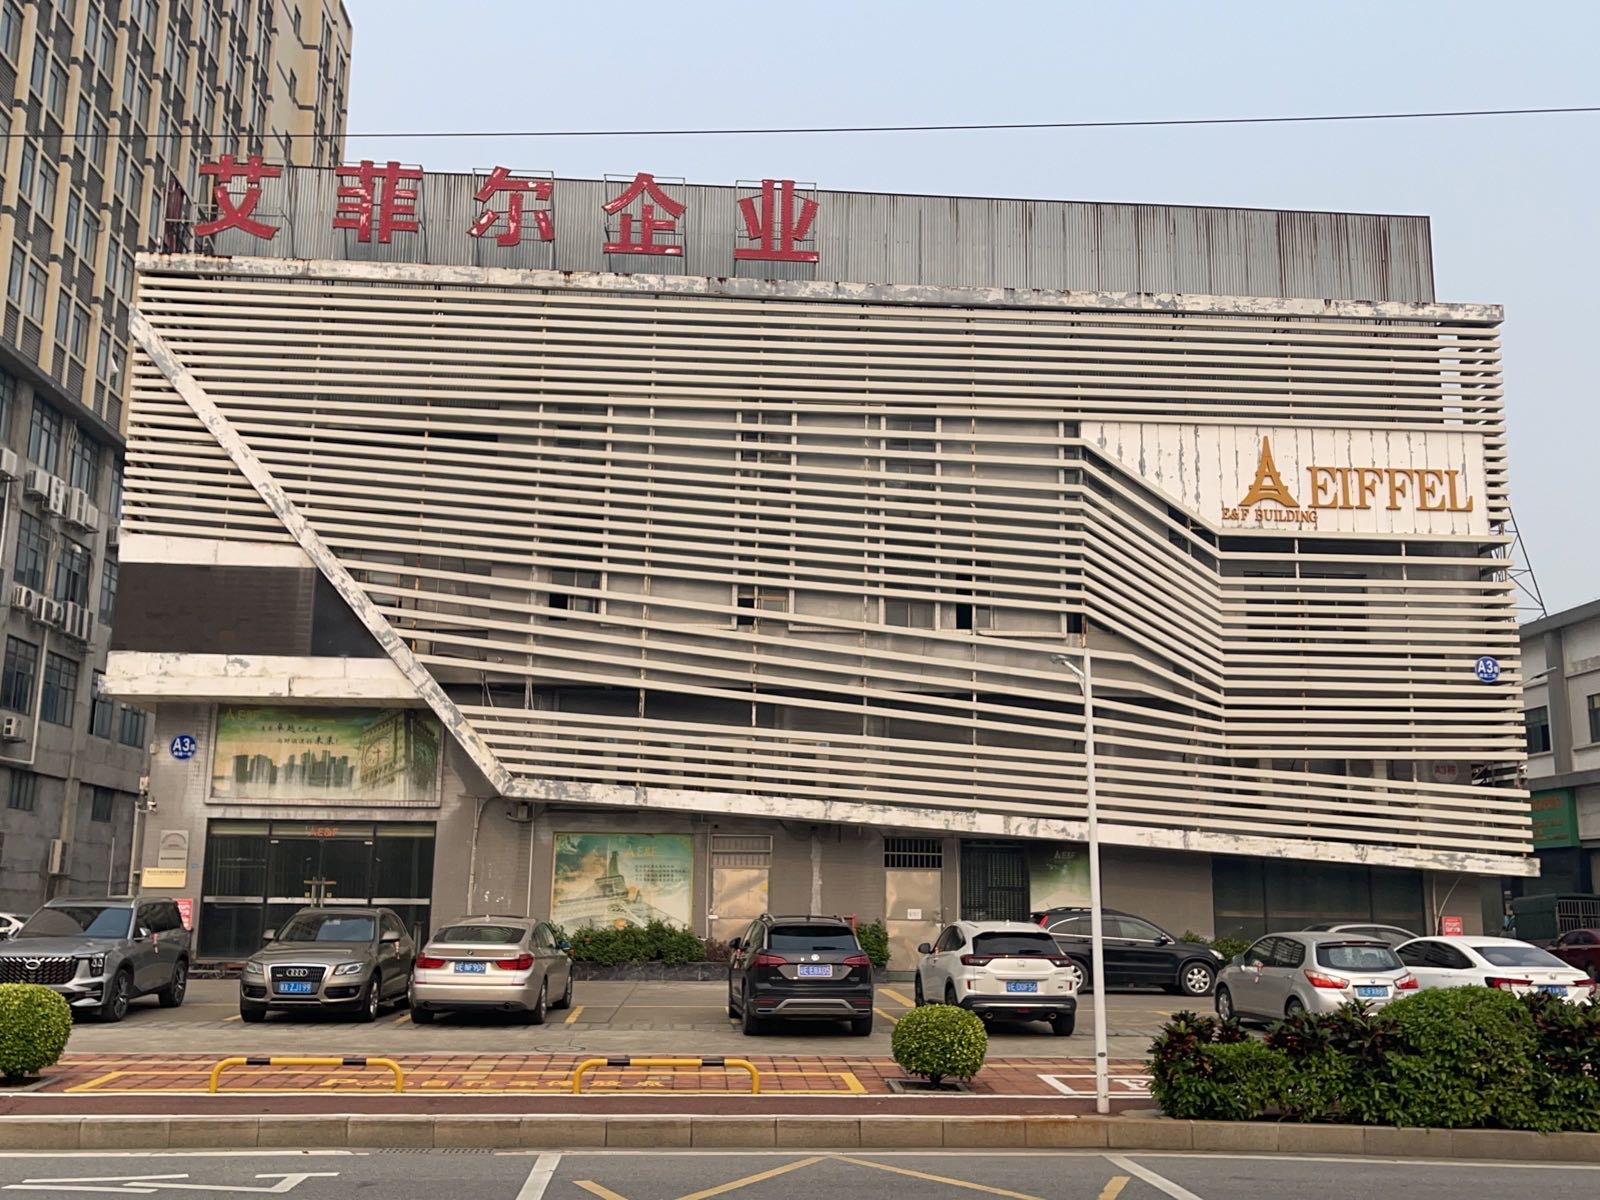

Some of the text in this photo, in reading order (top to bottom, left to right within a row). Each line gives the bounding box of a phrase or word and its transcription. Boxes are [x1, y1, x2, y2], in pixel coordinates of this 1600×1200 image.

[194, 154, 820, 263] 艾菲尔企业
[1307, 466, 1474, 512] EIFFEL
[1222, 508, 1318, 523] E&F BUILDING
